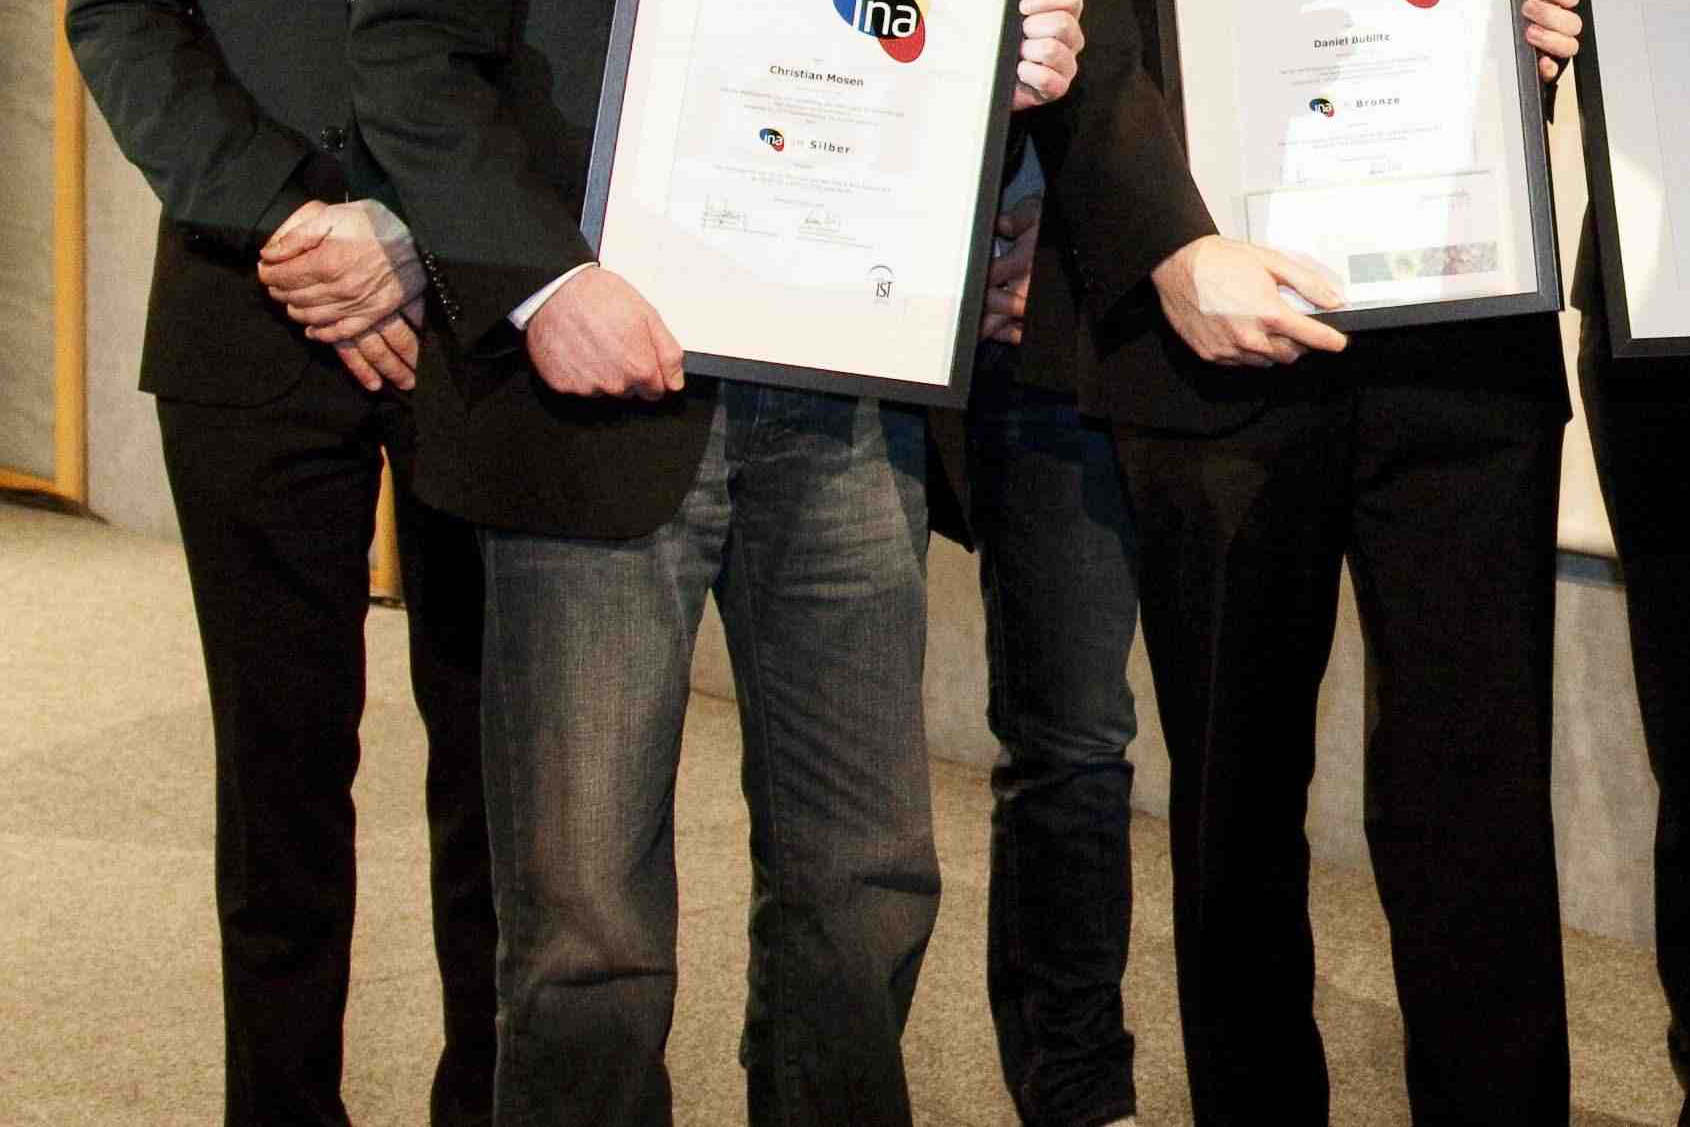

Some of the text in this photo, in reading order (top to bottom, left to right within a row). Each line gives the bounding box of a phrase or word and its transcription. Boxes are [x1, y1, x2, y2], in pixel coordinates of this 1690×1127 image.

[1313, 36, 1349, 48] Daniel
[769, 65, 864, 86] Christian Mosen
[1356, 97, 1400, 108] Bronze
[809, 139, 851, 154] Silber
